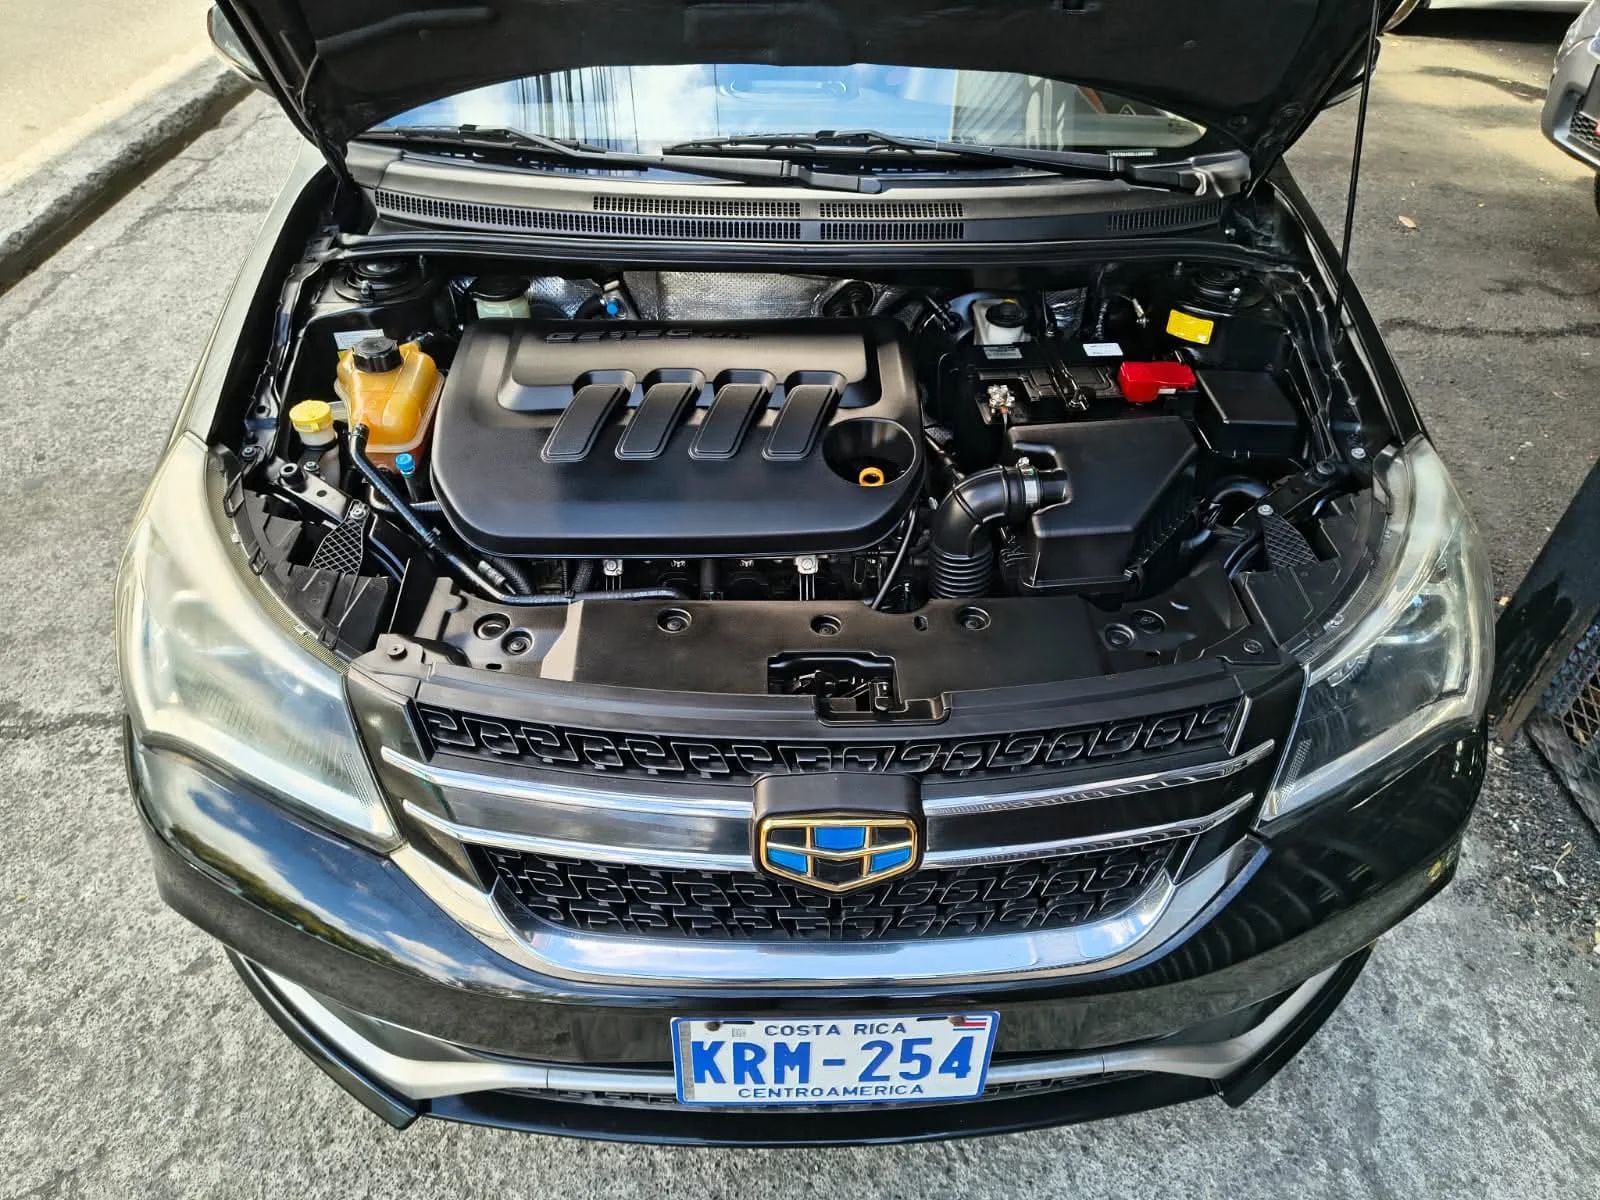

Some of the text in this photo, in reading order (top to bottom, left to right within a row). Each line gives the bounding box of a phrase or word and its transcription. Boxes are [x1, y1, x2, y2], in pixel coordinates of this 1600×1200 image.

[764, 1022, 907, 1037] COSTA RICA
[691, 1036, 975, 1085] KRM-254
[738, 1084, 924, 1099] CENTROAMERICA
